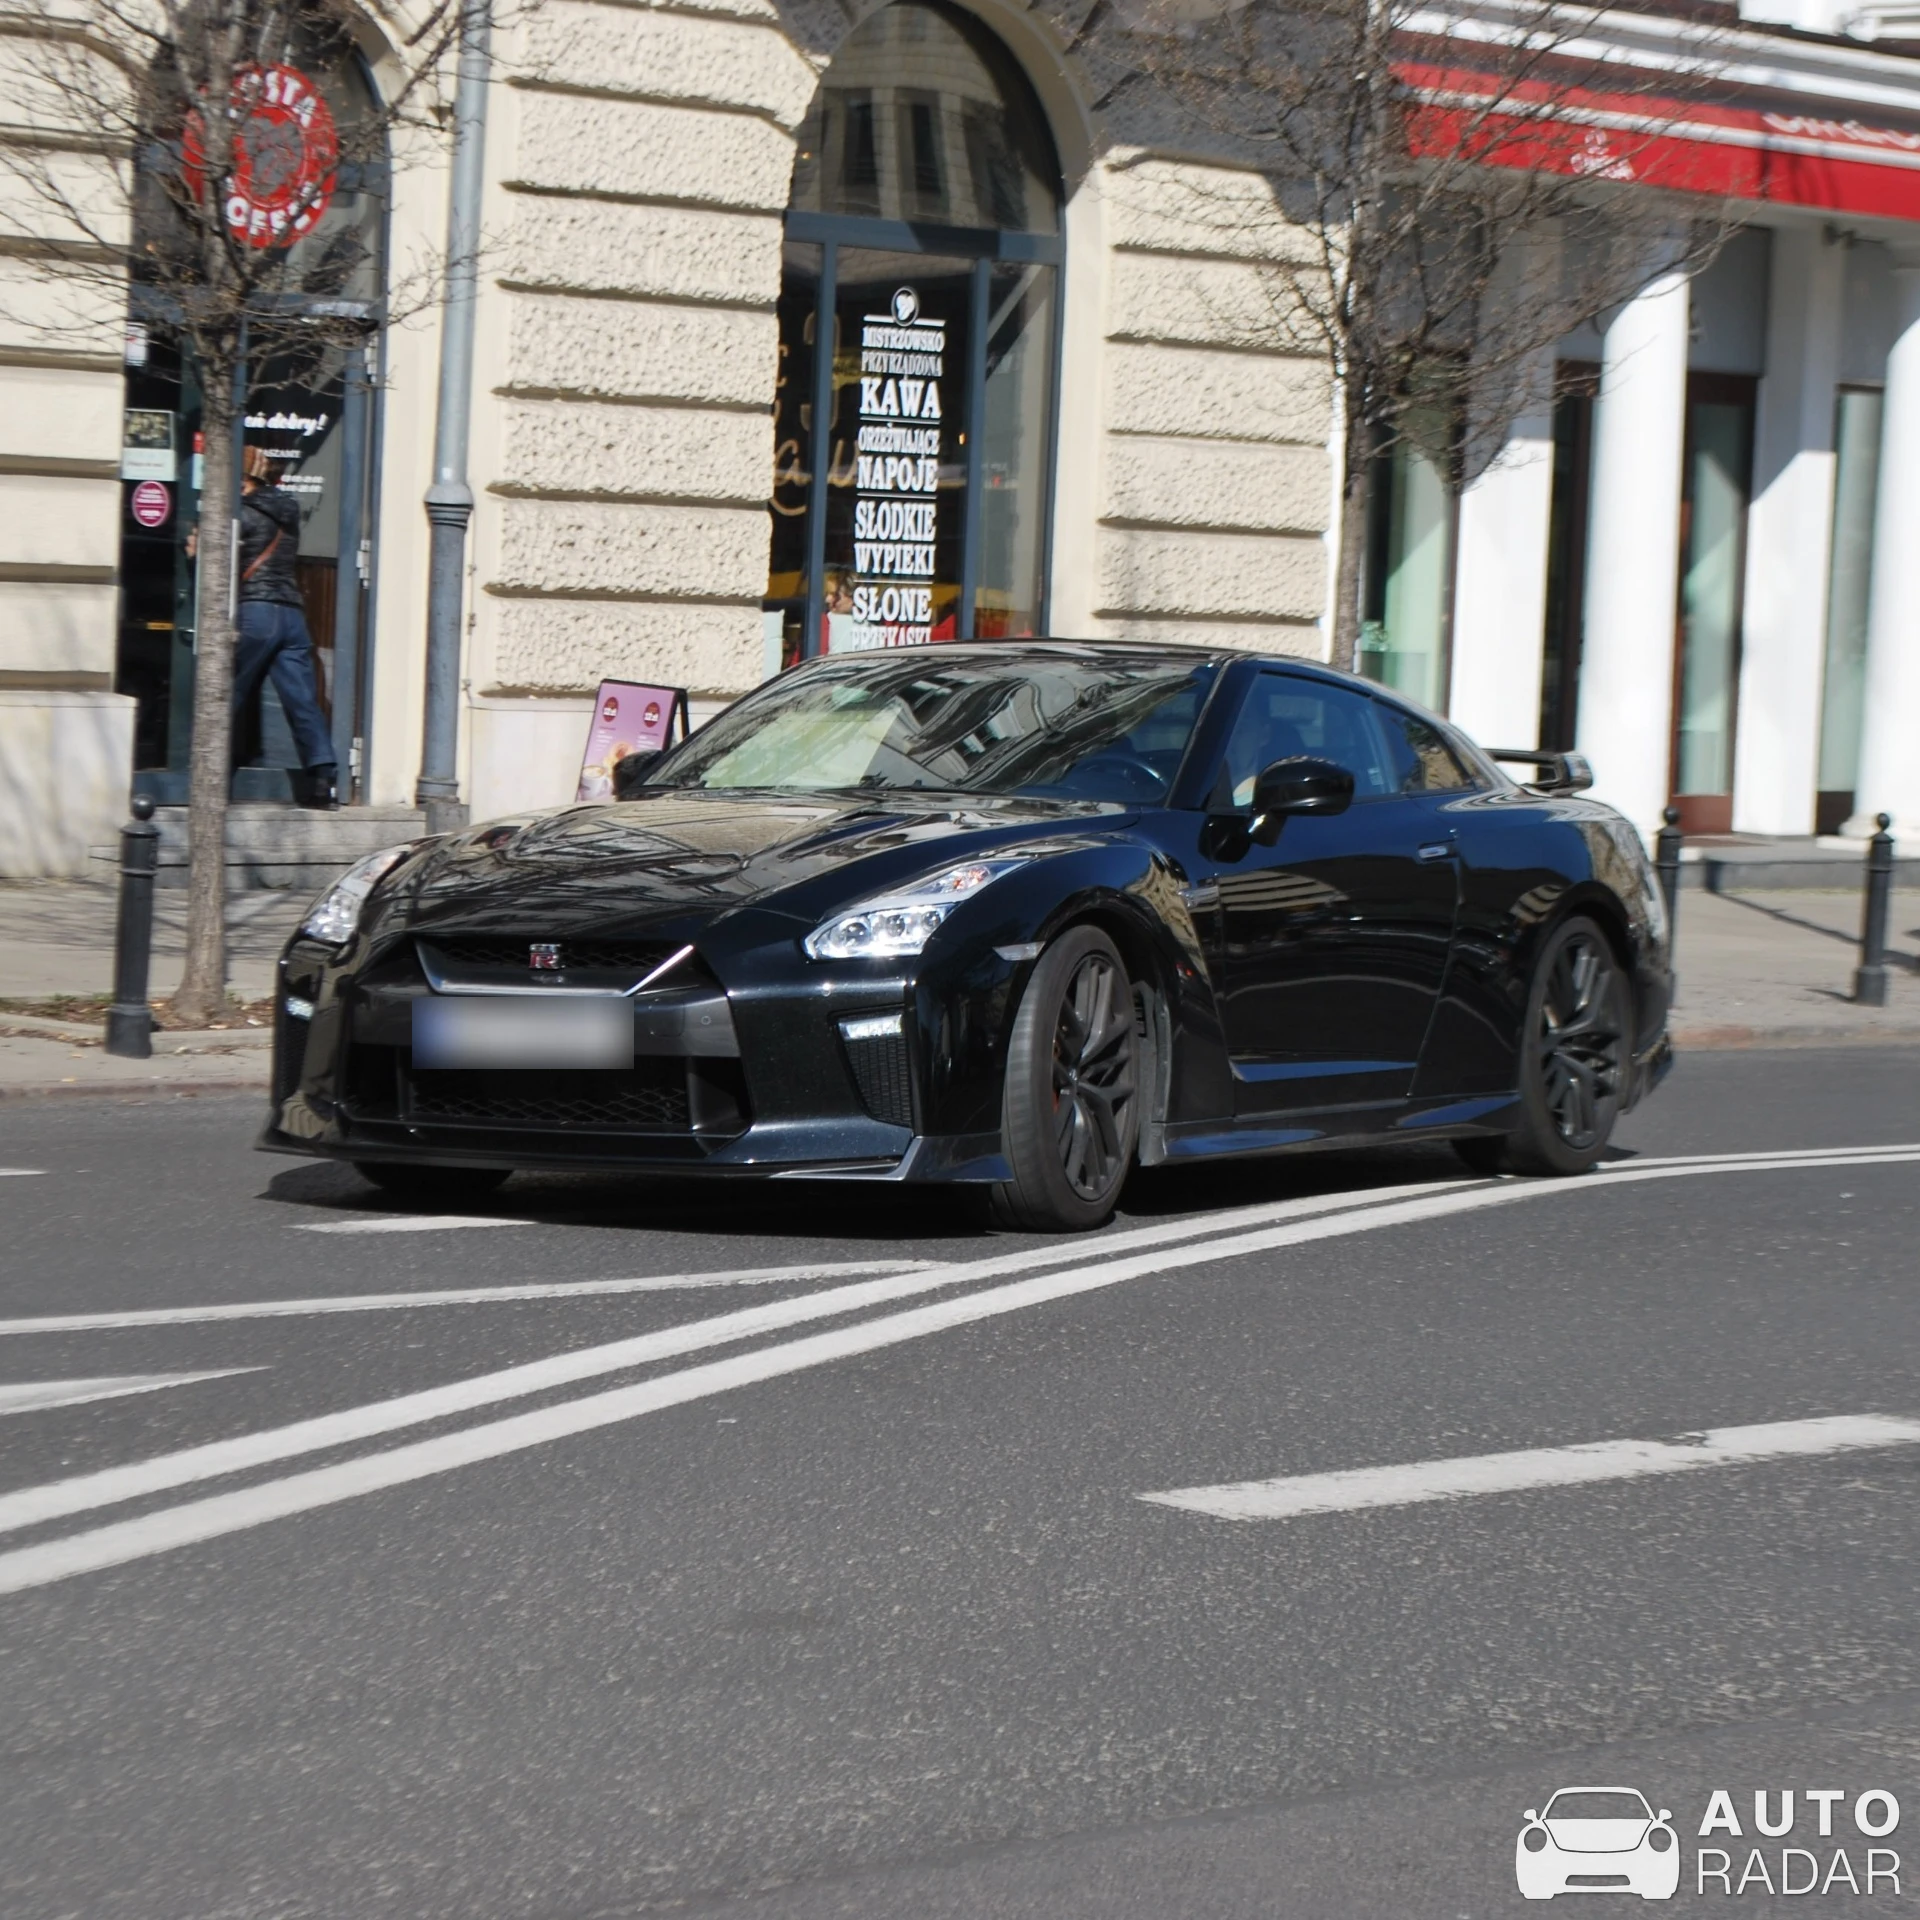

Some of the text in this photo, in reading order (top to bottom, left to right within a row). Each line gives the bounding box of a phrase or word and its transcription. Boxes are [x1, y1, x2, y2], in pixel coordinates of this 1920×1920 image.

[862, 326, 945, 352] MISTRZOWSKO
[859, 377, 942, 418] KAWA
[856, 455, 939, 492] NAPOJE
[855, 500, 937, 541] SŁODKIE
[854, 542, 936, 575] WYPIEKI
[852, 586, 932, 622] SŁONE
